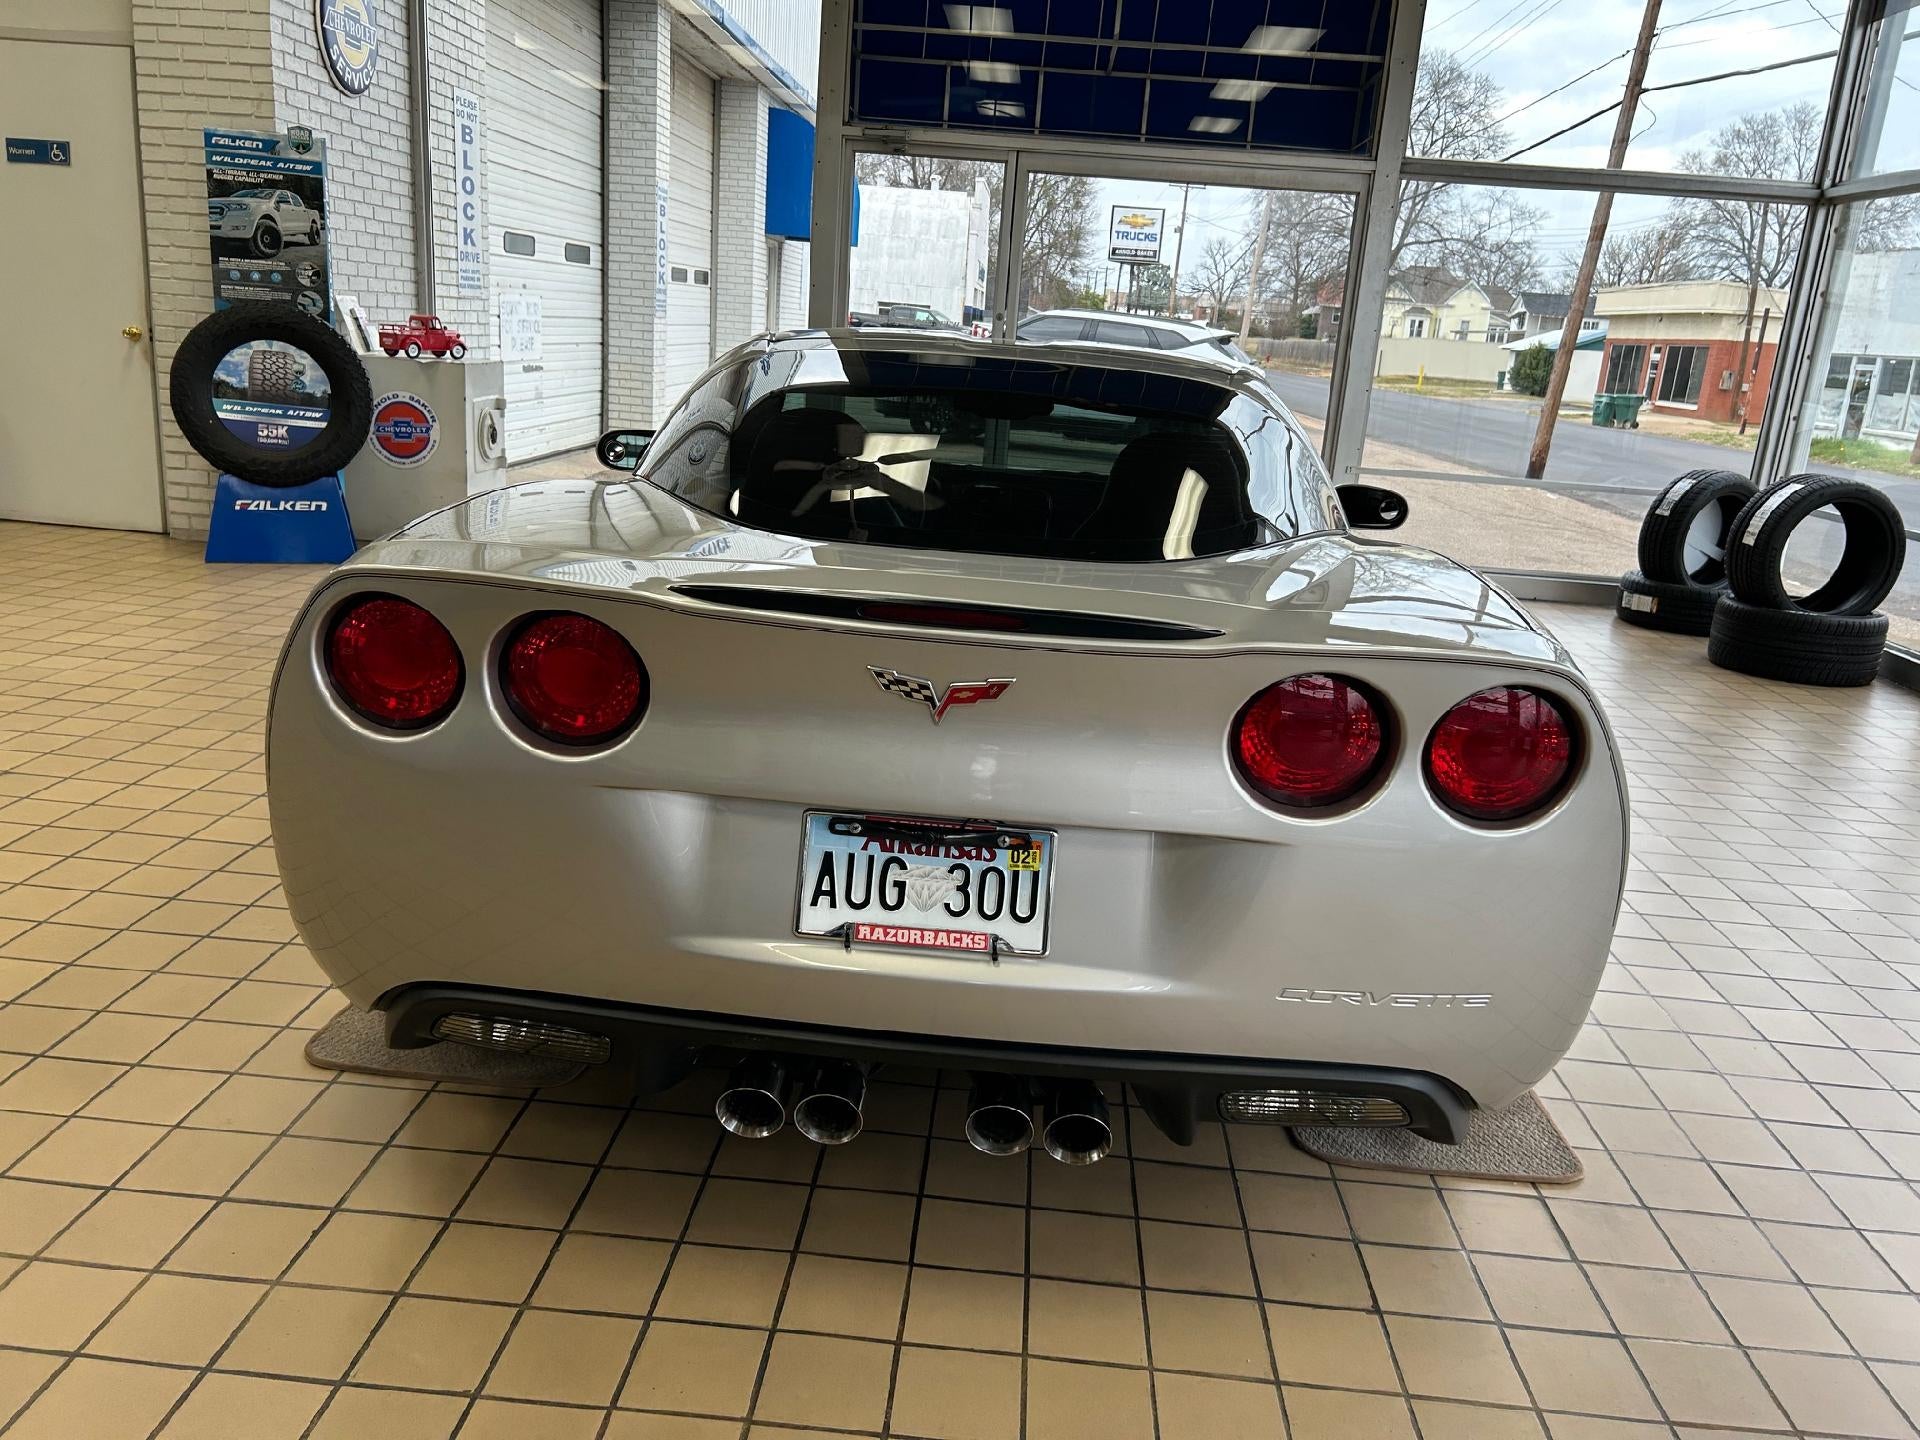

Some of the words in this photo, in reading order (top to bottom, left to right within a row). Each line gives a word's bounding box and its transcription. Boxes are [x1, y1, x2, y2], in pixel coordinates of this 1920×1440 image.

[329, 10, 375, 46] CHEVROLET
[330, 44, 375, 90] SERVICE
[455, 95, 478, 111] PLEASE
[456, 108, 465, 118] DO
[466, 111, 478, 124] NOT
[211, 136, 263, 149] FALKEN
[8, 146, 36, 156] Women
[211, 155, 274, 167] WILDPEAK
[461, 123, 476, 247] BLOCK
[658, 204, 666, 285] BLOCK
[1114, 230, 1158, 243] TRUCKS
[459, 250, 481, 264] DRIVE
[222, 404, 285, 415] WILDPEAK
[408, 394, 437, 423] BAKER
[257, 423, 289, 439] 55K
[234, 499, 328, 511] FALKEN
[1010, 850, 1031, 865] 02
[809, 850, 909, 913] AUG
[943, 861, 1041, 925] 30U
[856, 924, 988, 949] RAZORBACKS
[1275, 987, 1494, 1008] CORVETTE
